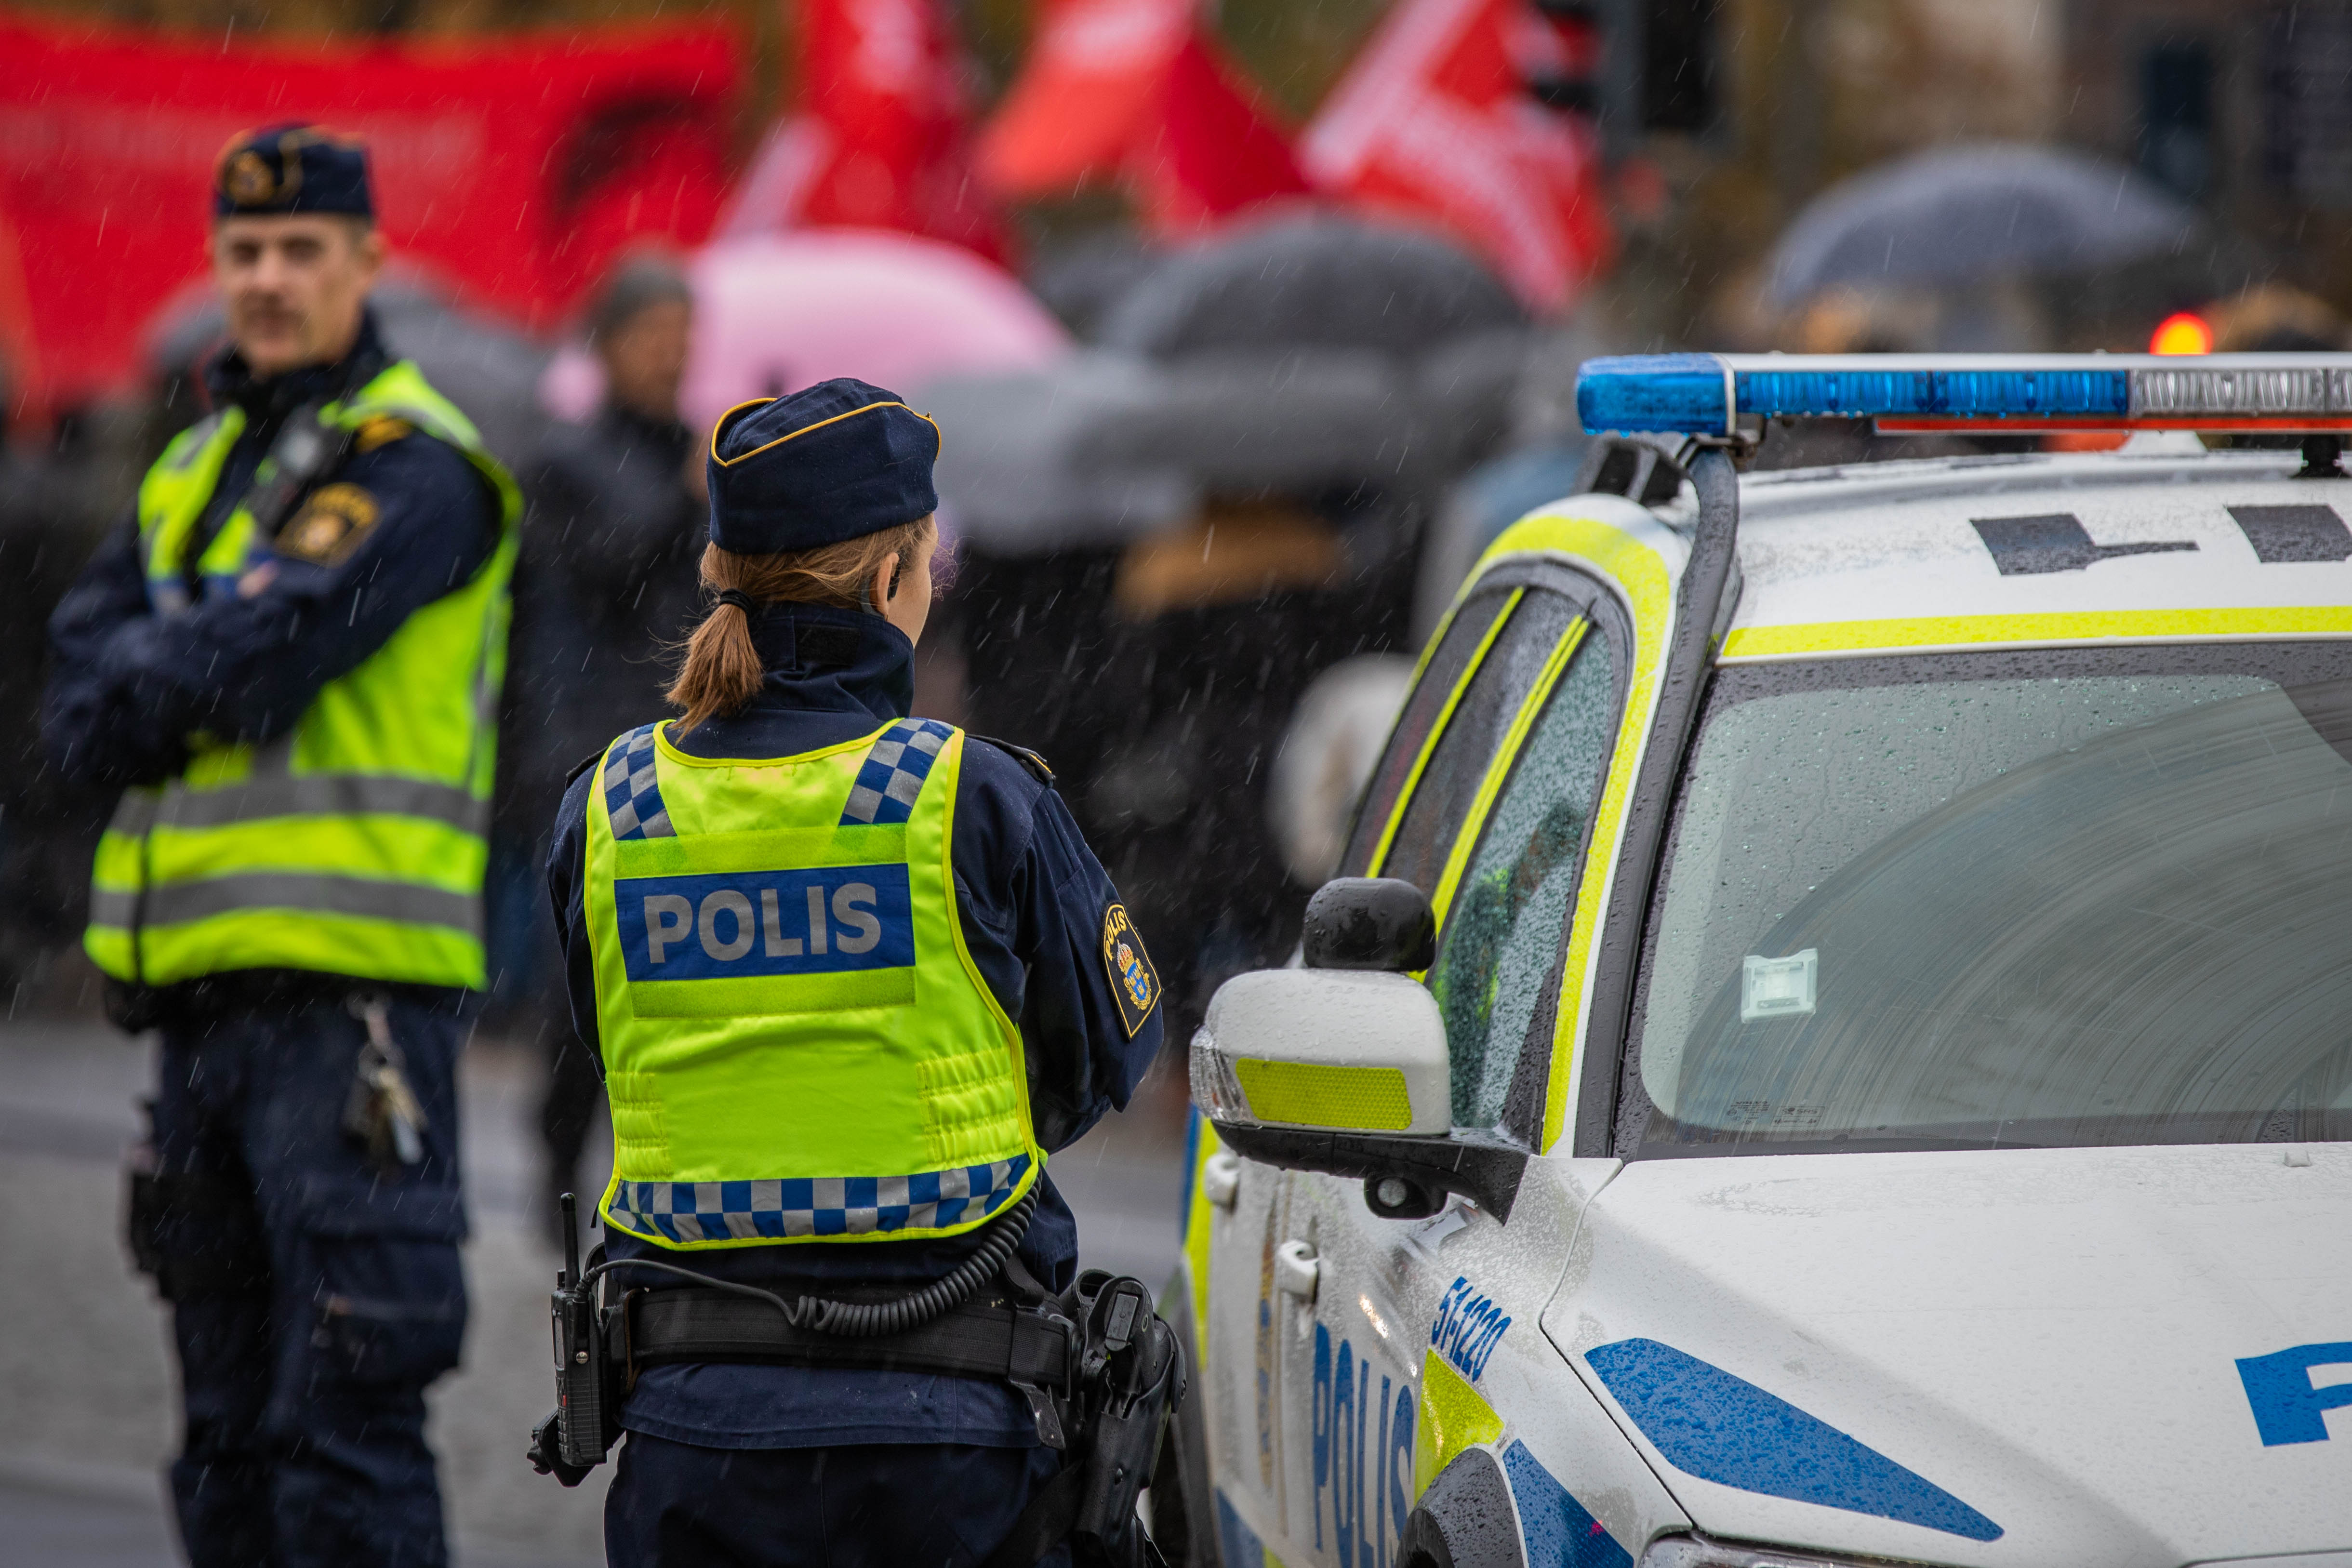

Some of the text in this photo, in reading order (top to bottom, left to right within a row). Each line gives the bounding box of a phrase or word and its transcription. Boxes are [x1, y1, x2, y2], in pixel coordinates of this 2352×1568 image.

[643, 882, 881, 964] POLIS
[1105, 910, 1127, 961] POLIS
[1432, 1276, 1512, 1383] 51-1220
